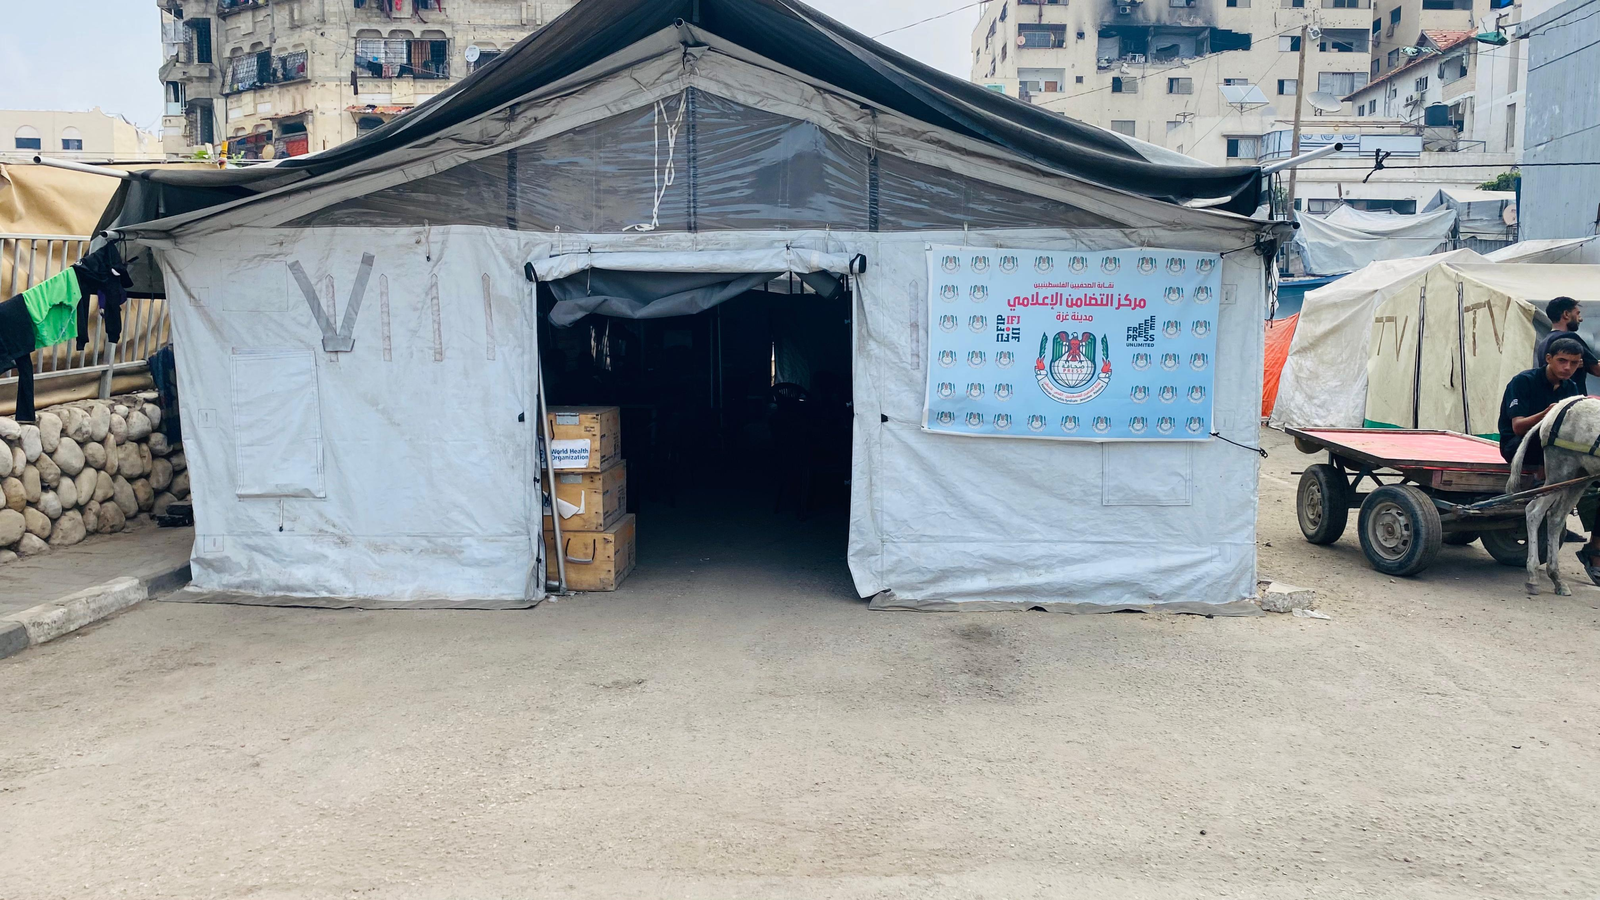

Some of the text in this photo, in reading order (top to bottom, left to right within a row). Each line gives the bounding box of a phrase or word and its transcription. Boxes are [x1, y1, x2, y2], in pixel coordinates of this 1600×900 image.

[1033, 281, 1069, 290] الفلسطينيين
[1070, 281, 1096, 290] الصحفيين
[1007, 291, 1147, 311] مركز التضامن الإعلامي
[1006, 315, 1021, 325] IFJ
[1056, 311, 1094, 324] مدينة غزة
[1463, 296, 1511, 357] TV
[1374, 315, 1409, 362] TV
[551, 447, 589, 456] World Health
